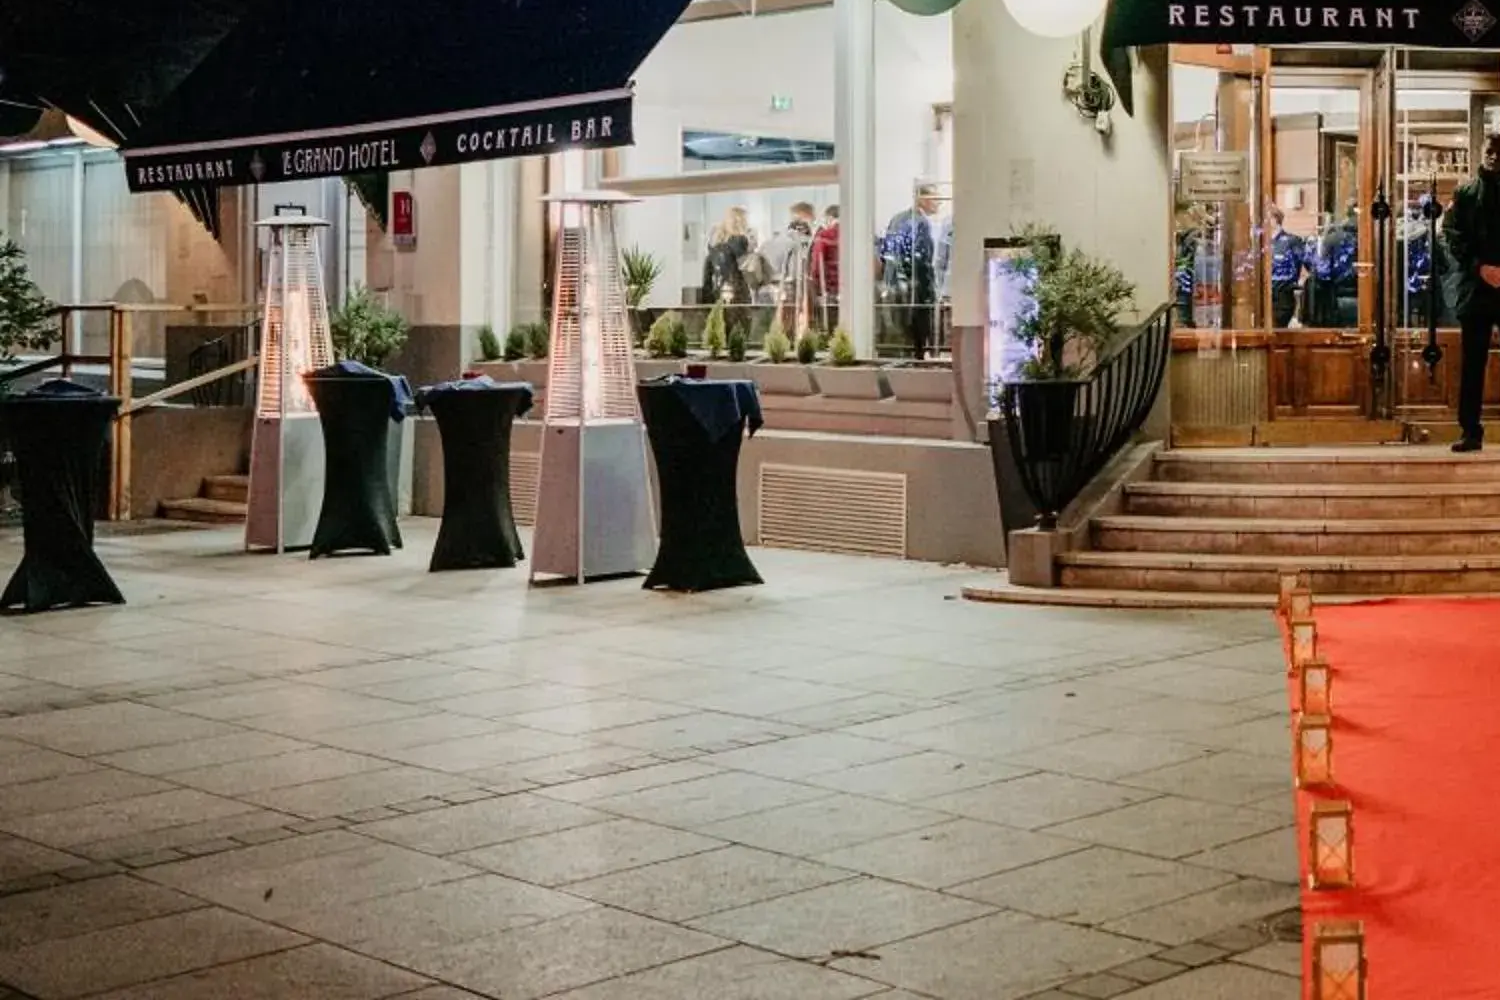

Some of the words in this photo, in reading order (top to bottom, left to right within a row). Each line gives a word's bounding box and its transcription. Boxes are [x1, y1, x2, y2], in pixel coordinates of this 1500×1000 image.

[1168, 4, 1420, 29] RESTAURANT
[138, 159, 234, 185] RESTAURANT
[293, 146, 346, 174] GRAND
[347, 139, 400, 169] HOTEL
[457, 123, 557, 153] COCKTAIL
[571, 116, 614, 142] BAR
